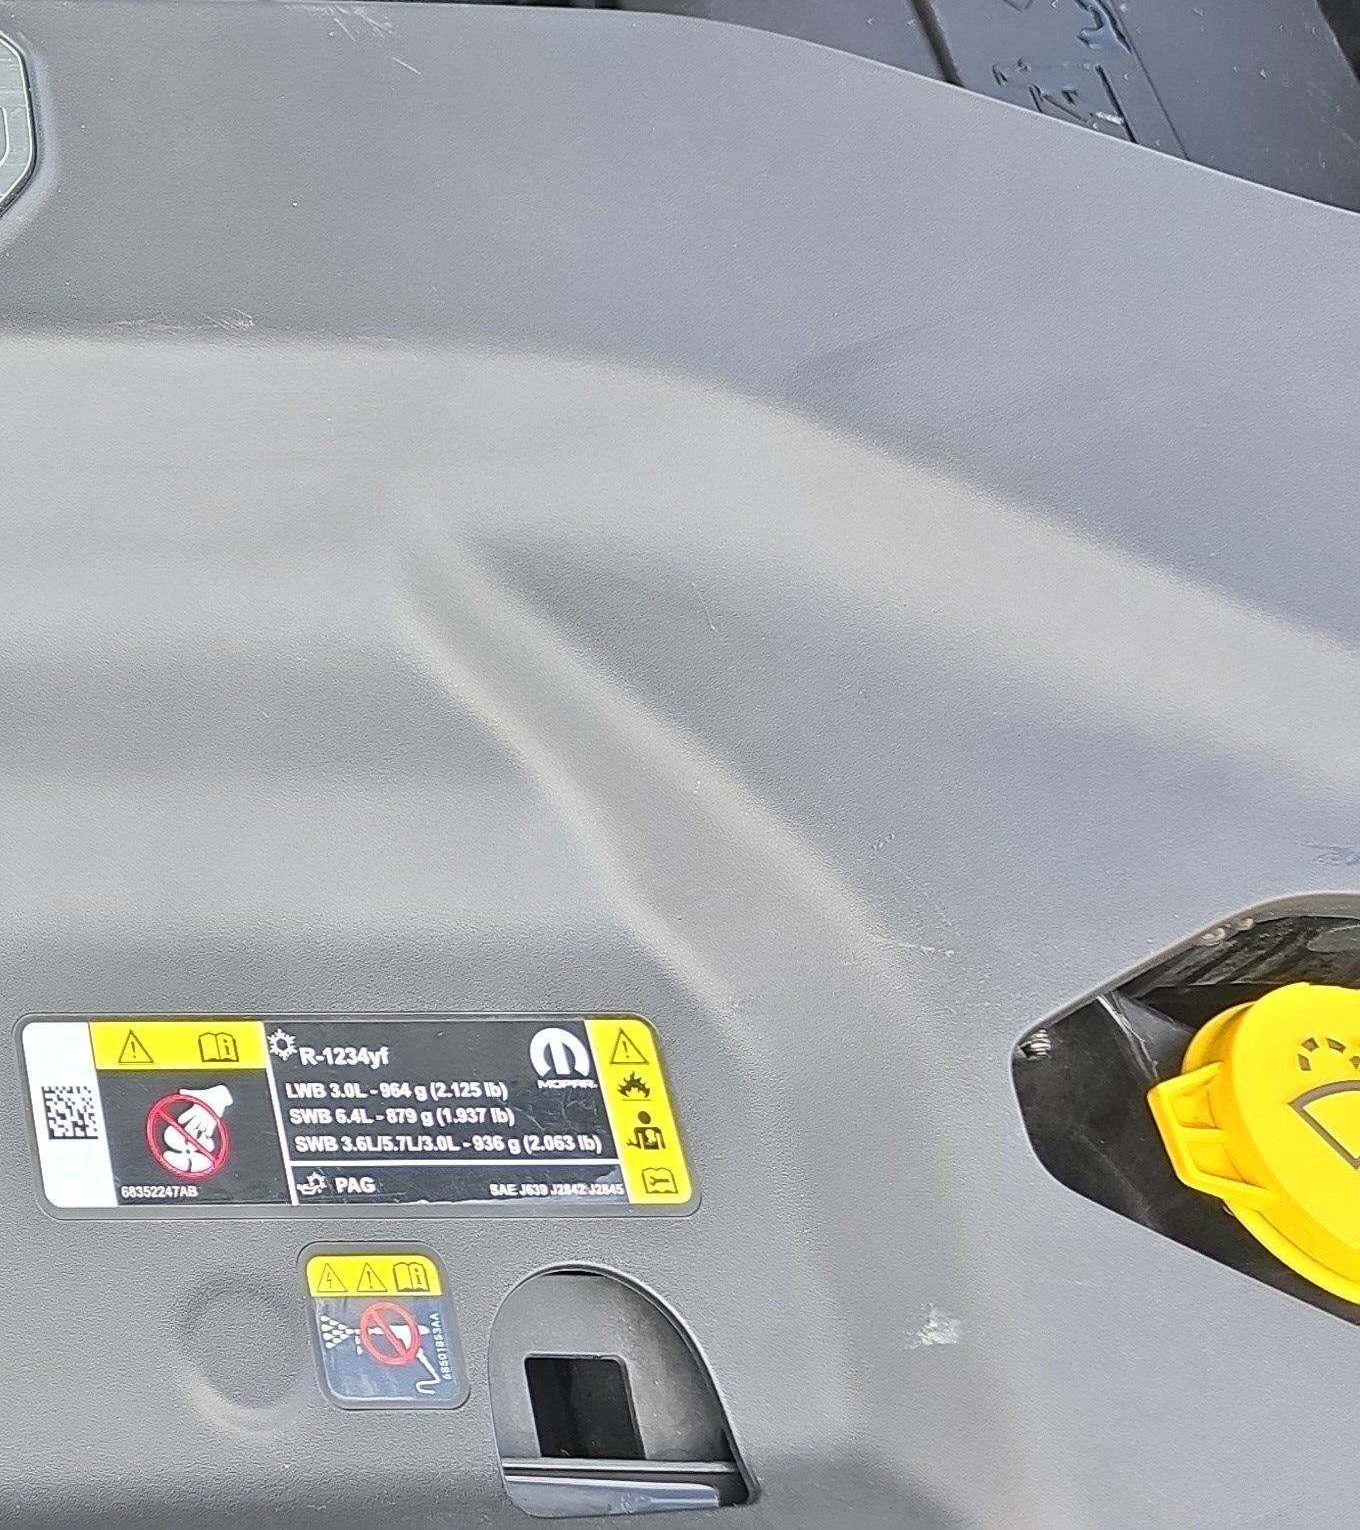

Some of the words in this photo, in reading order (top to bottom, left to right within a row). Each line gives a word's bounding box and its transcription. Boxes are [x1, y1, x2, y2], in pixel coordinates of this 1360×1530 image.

[299, 1046, 390, 1070] R-1234yf
[285, 1082, 327, 1099] LWB
[329, 1082, 369, 1099] 3.0L
[380, 1082, 412, 1099] 964
[414, 1084, 428, 1102] g
[430, 1081, 482, 1102] (2.125
[484, 1081, 509, 1102] lb)
[289, 1107, 333, 1125] SWB
[335, 1107, 375, 1125] 6.4L
[386, 1107, 418, 1124] 879
[420, 1110, 434, 1127] g
[436, 1107, 488, 1127] (1.937
[490, 1107, 516, 1127] lb)
[295, 1135, 339, 1153] SWB
[340, 1135, 461, 1152] 3.6L/5.7L/3.0L
[472, 1135, 505, 1152] 936
[507, 1138, 523, 1155] g
[524, 1135, 575, 1155] (2.063
[577, 1134, 603, 1155] lb)
[121, 1185, 199, 1199] 68352247AB
[335, 1176, 377, 1195] PAG
[489, 1183, 518, 1197] SAE
[519, 1183, 549, 1197] J639
[550, 1183, 588, 1197] J2842
[589, 1183, 626, 1197] J2845
